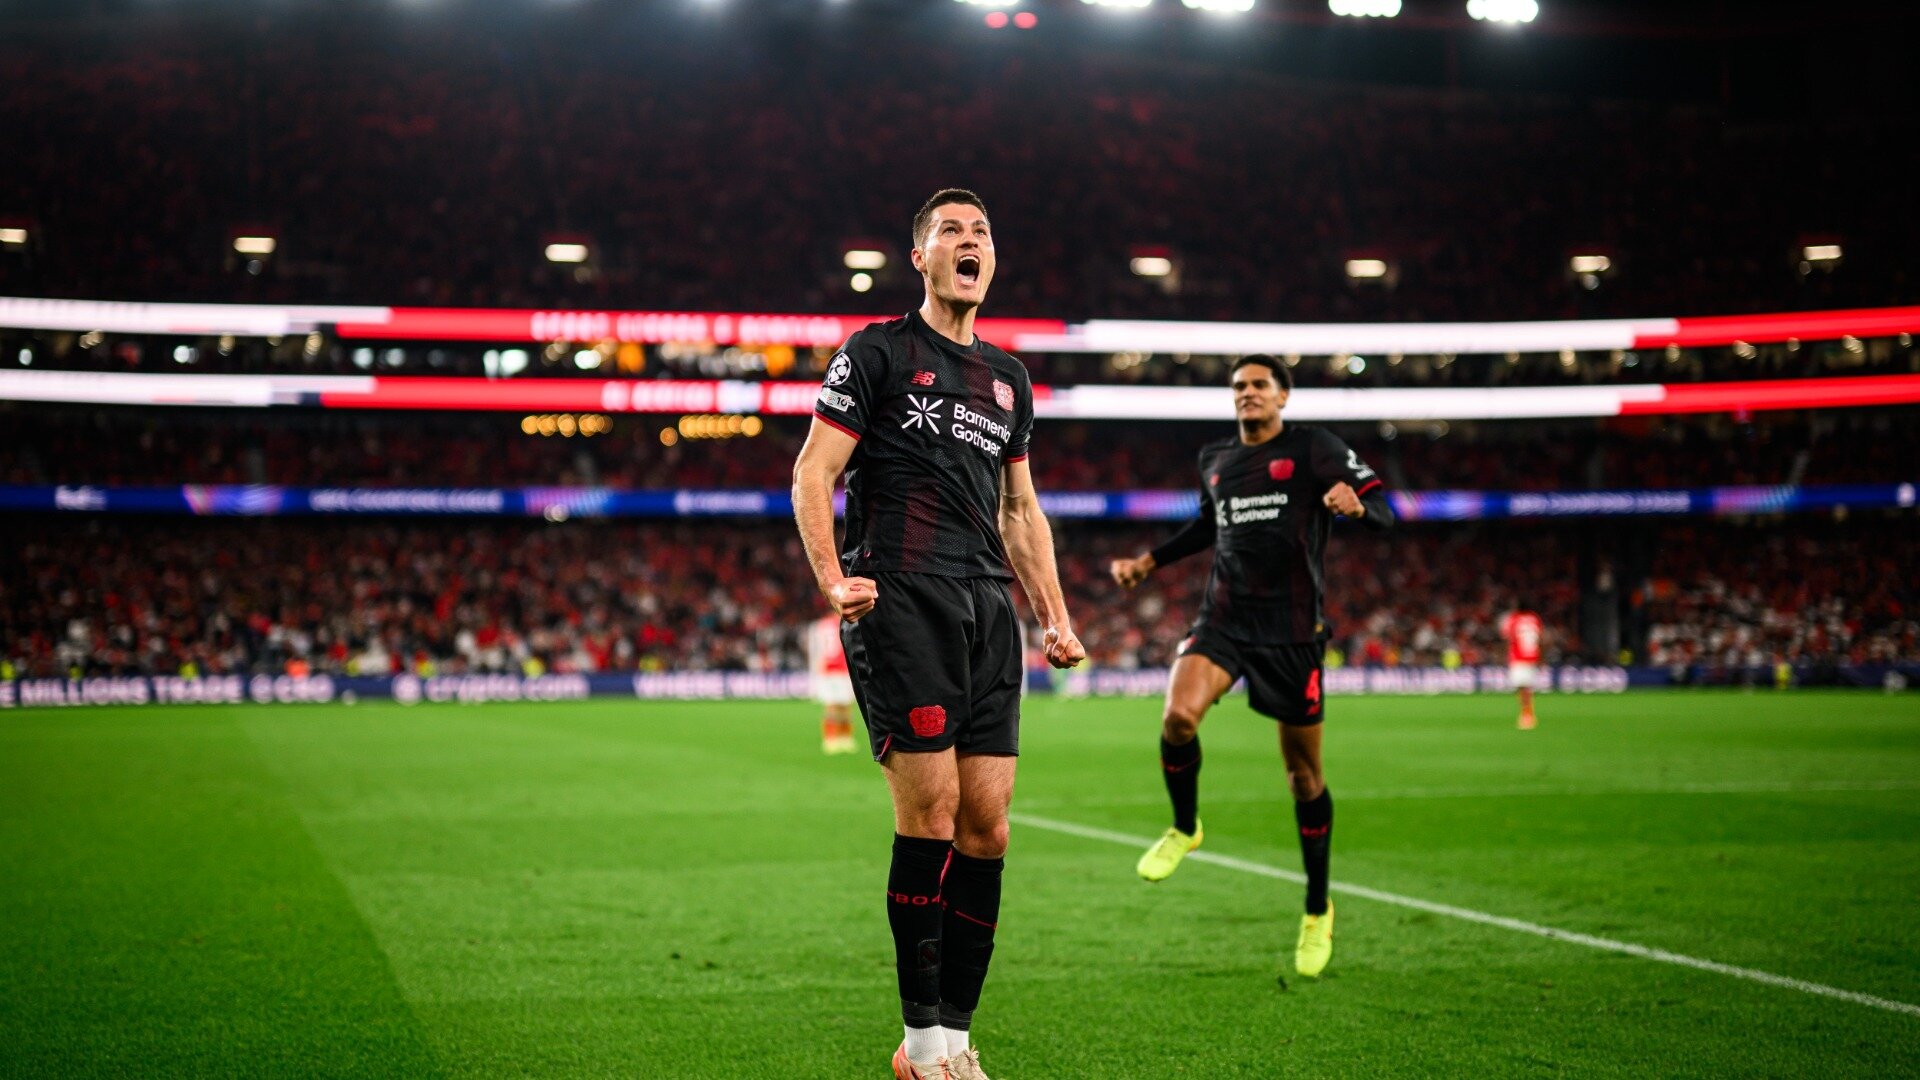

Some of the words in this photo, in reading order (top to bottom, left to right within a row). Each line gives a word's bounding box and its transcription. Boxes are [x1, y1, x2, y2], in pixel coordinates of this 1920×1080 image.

[951, 423, 1001, 457] Gothaer
[953, 402, 1011, 444] Barmenia
[1230, 491, 1288, 511] Barmenia
[1231, 508, 1280, 524] Gothaer
[1305, 668, 1320, 702] 4
